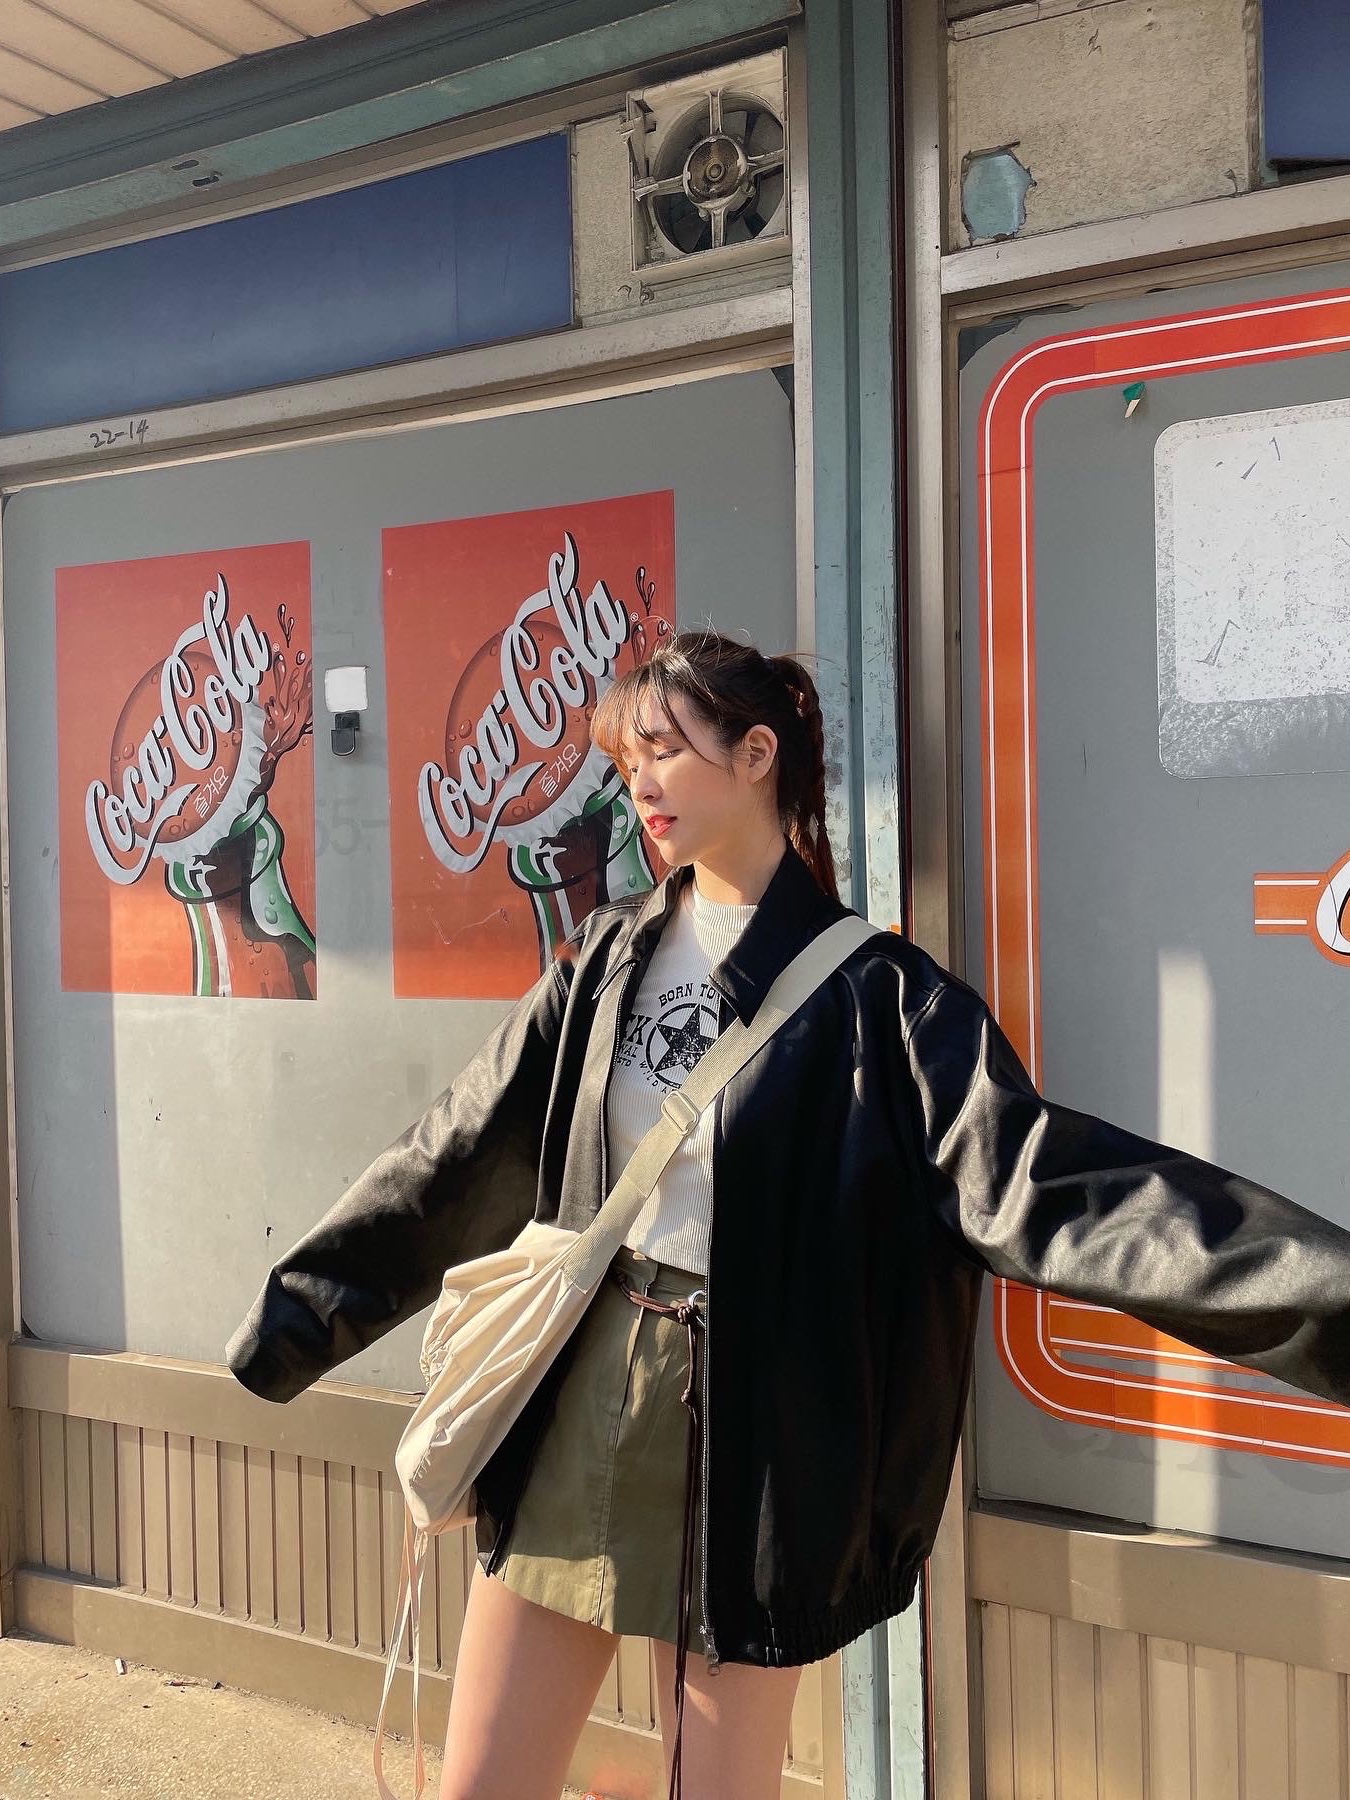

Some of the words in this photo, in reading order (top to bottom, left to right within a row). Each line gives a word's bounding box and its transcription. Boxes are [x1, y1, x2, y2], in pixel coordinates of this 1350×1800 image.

[90, 418, 149, 448] 22-14
[418, 530, 630, 873] Coca-Cola
[85, 573, 274, 885] Coca-Cola
[193, 766, 229, 818] 즐겨요
[539, 743, 582, 798] 즐겨요
[658, 983, 693, 1008] BORN
[699, 983, 716, 1000] TO
[639, 1060, 659, 1087] WILD
